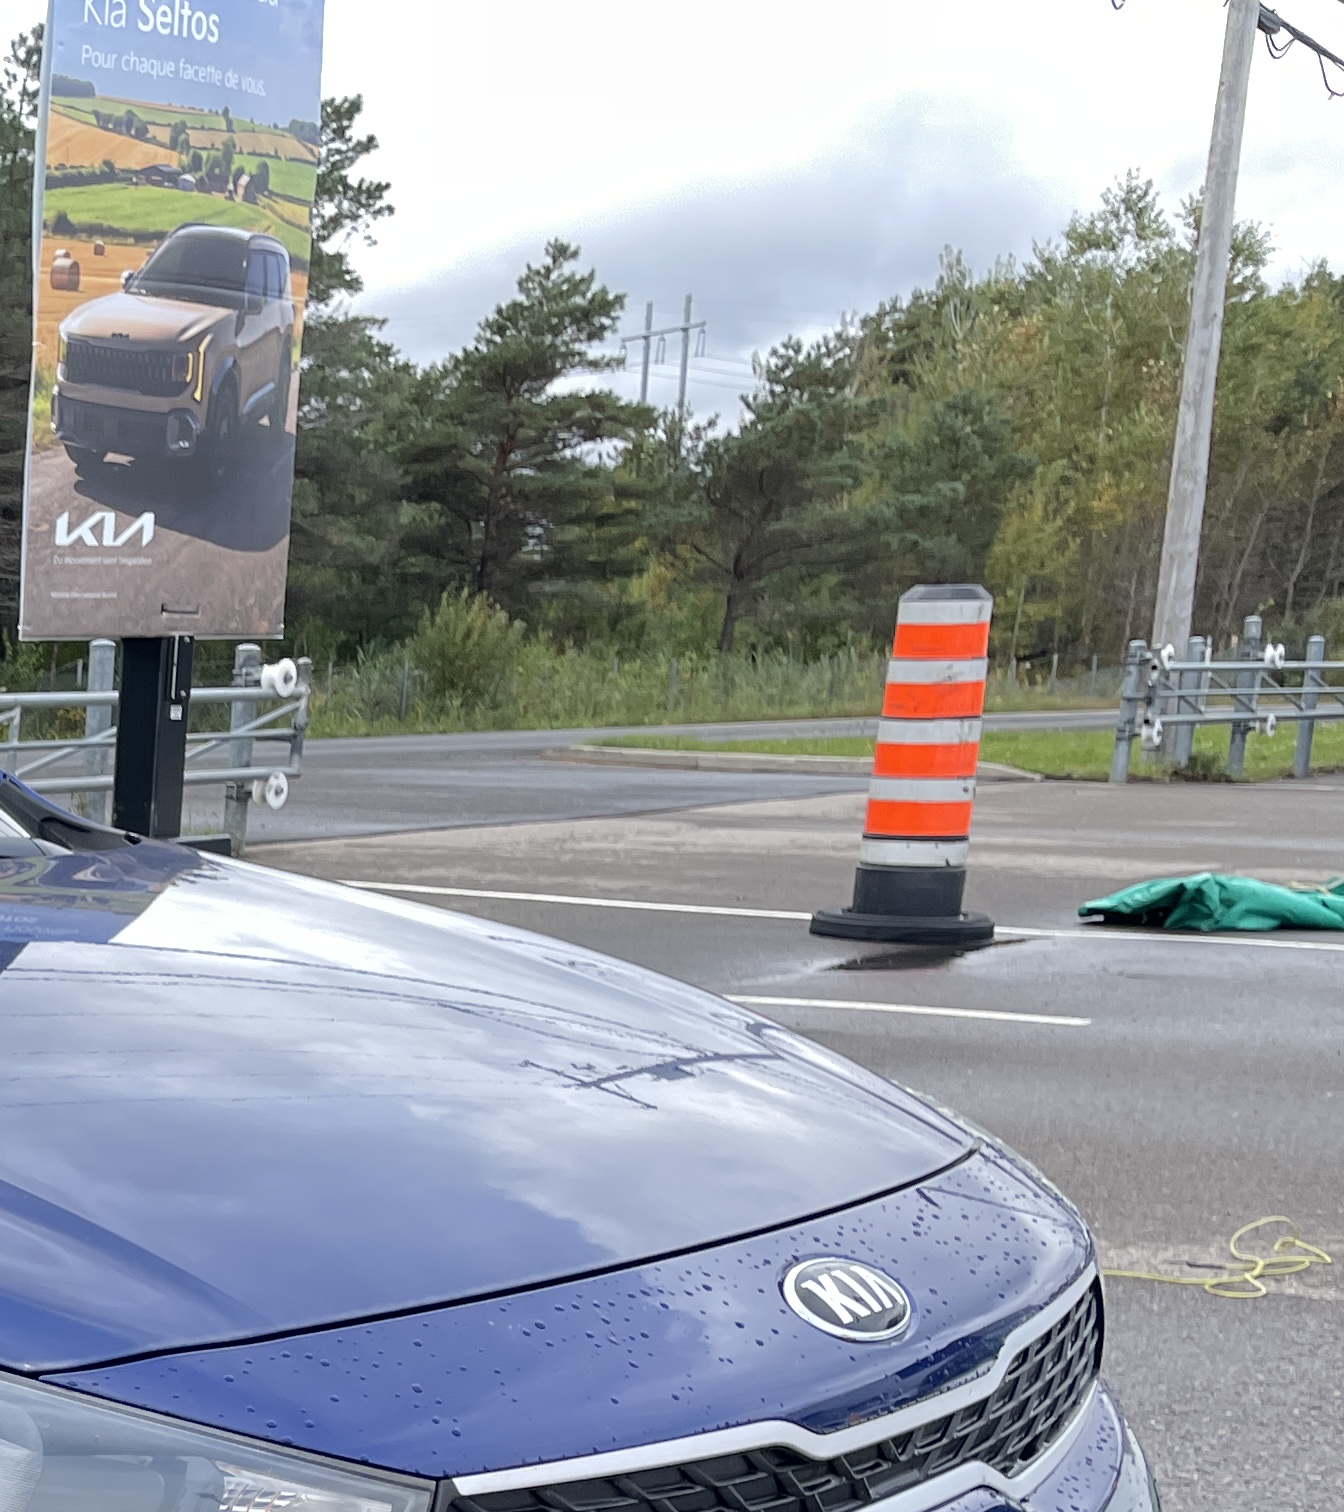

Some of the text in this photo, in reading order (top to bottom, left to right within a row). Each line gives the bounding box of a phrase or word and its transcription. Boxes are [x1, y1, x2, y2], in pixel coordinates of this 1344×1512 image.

[83, 0, 220, 43] Kia Seltos
[80, 44, 117, 69] Pour
[121, 51, 176, 79] chaque
[178, 57, 223, 87] facette
[224, 68, 240, 91] de
[55, 510, 155, 548] KIA
[800, 1265, 905, 1325] KIA
